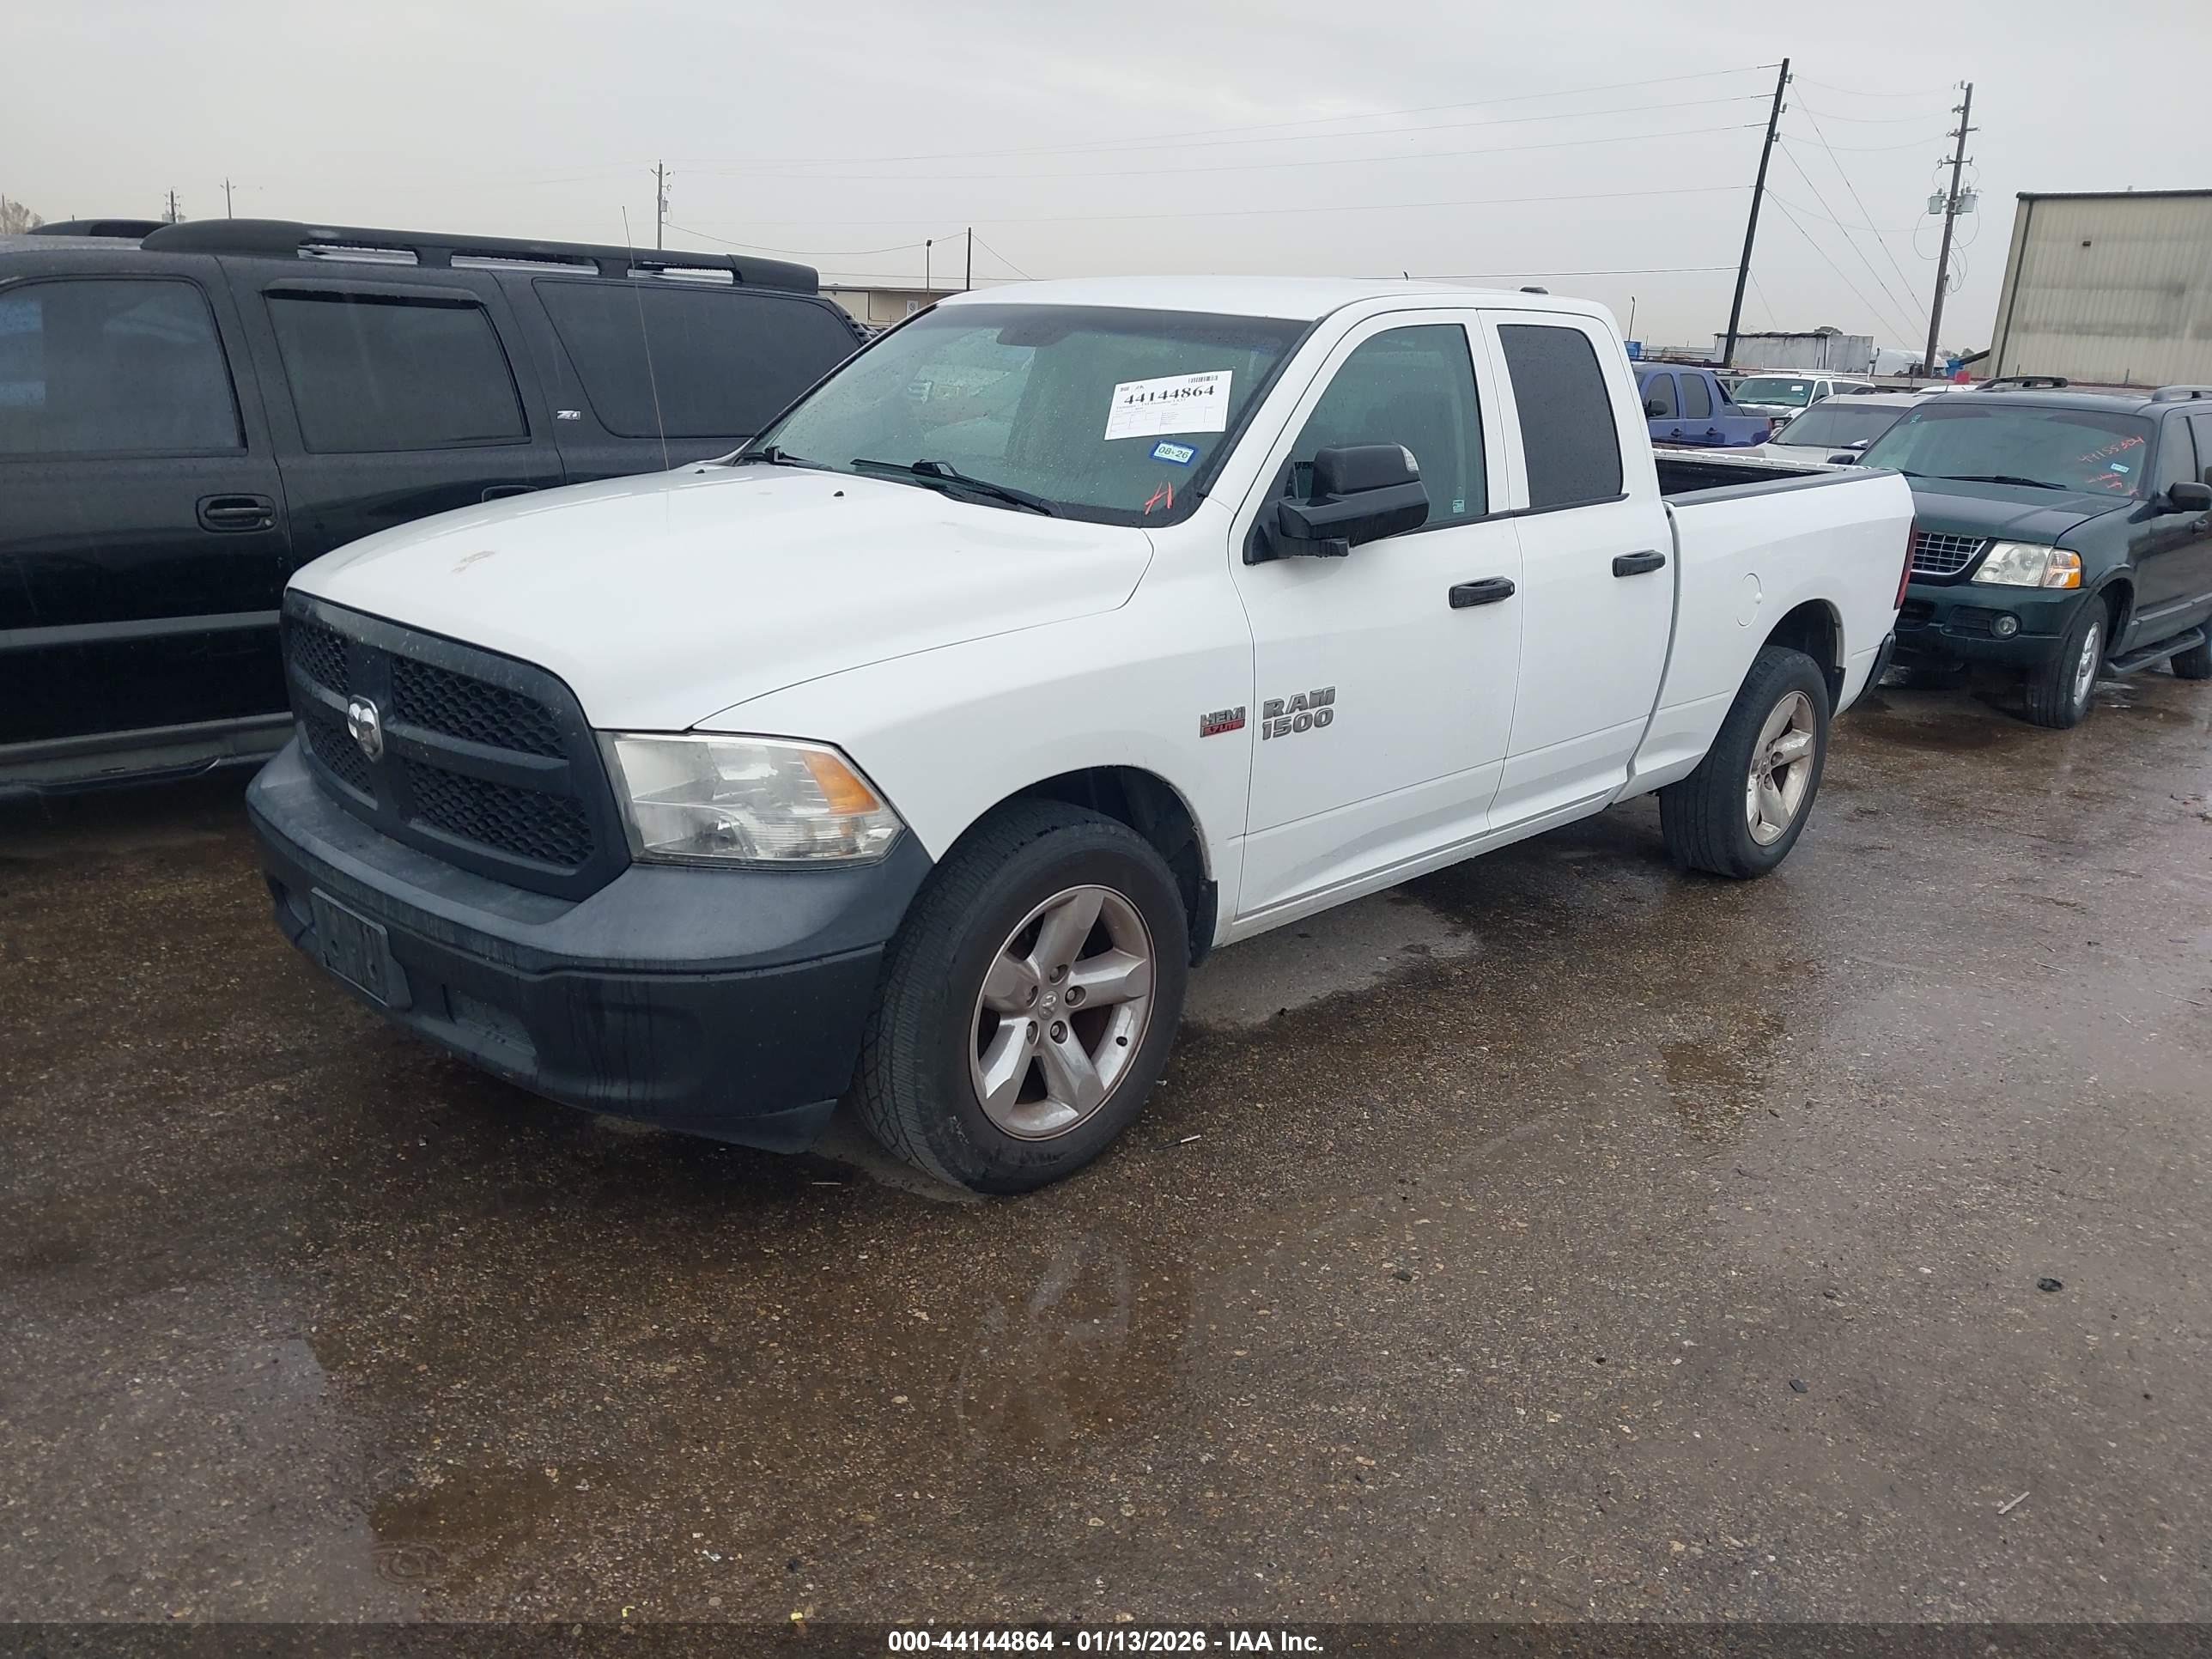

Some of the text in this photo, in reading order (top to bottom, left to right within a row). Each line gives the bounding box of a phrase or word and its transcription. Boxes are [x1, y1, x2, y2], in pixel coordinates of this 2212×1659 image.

[1124, 385, 1215, 404] 44144864
[1158, 446, 1189, 459] 08 26
[1262, 686, 1336, 720] RAM
[1200, 706, 1245, 726] HEMI
[1262, 707, 1334, 741] 1500
